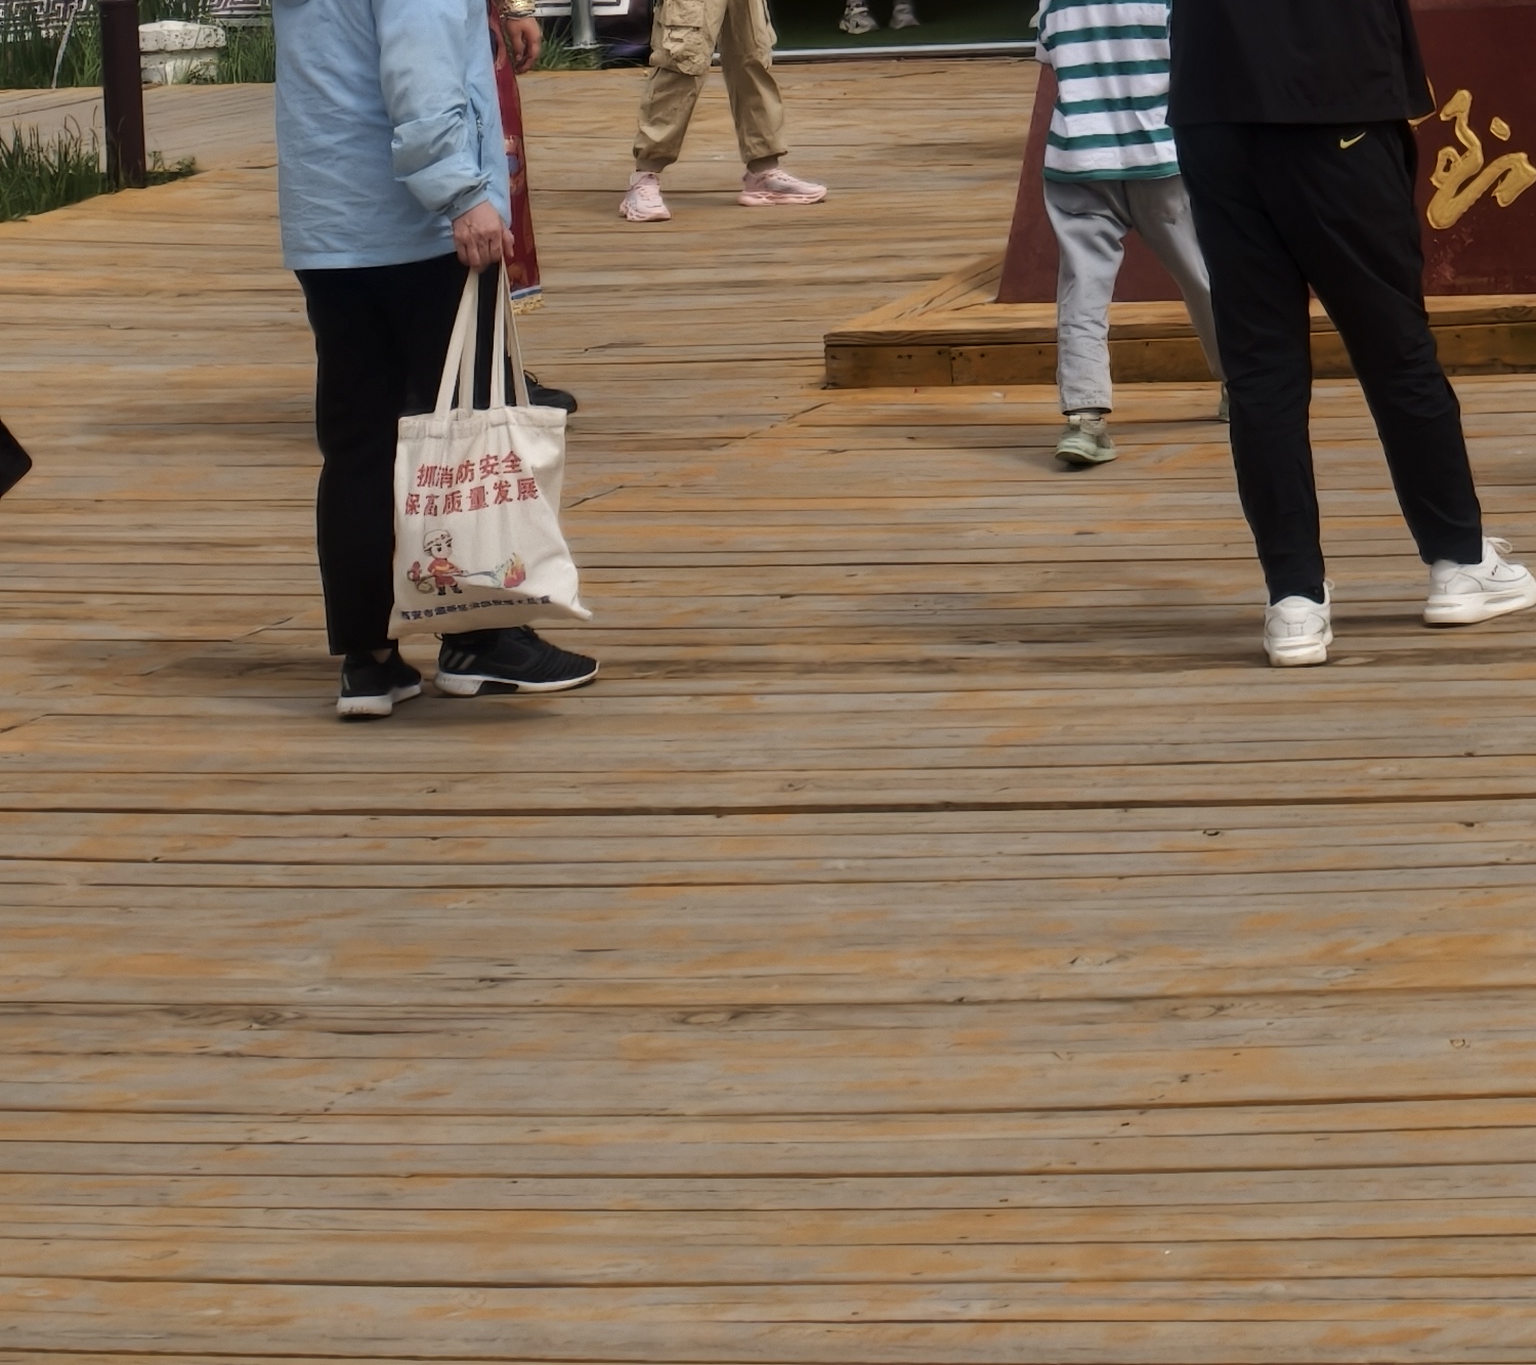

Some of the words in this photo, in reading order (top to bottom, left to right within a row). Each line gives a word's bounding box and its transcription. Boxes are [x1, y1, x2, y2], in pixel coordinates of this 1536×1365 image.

[417, 450, 522, 489] 抓消防安全
[404, 477, 539, 517] 保高质量发展
